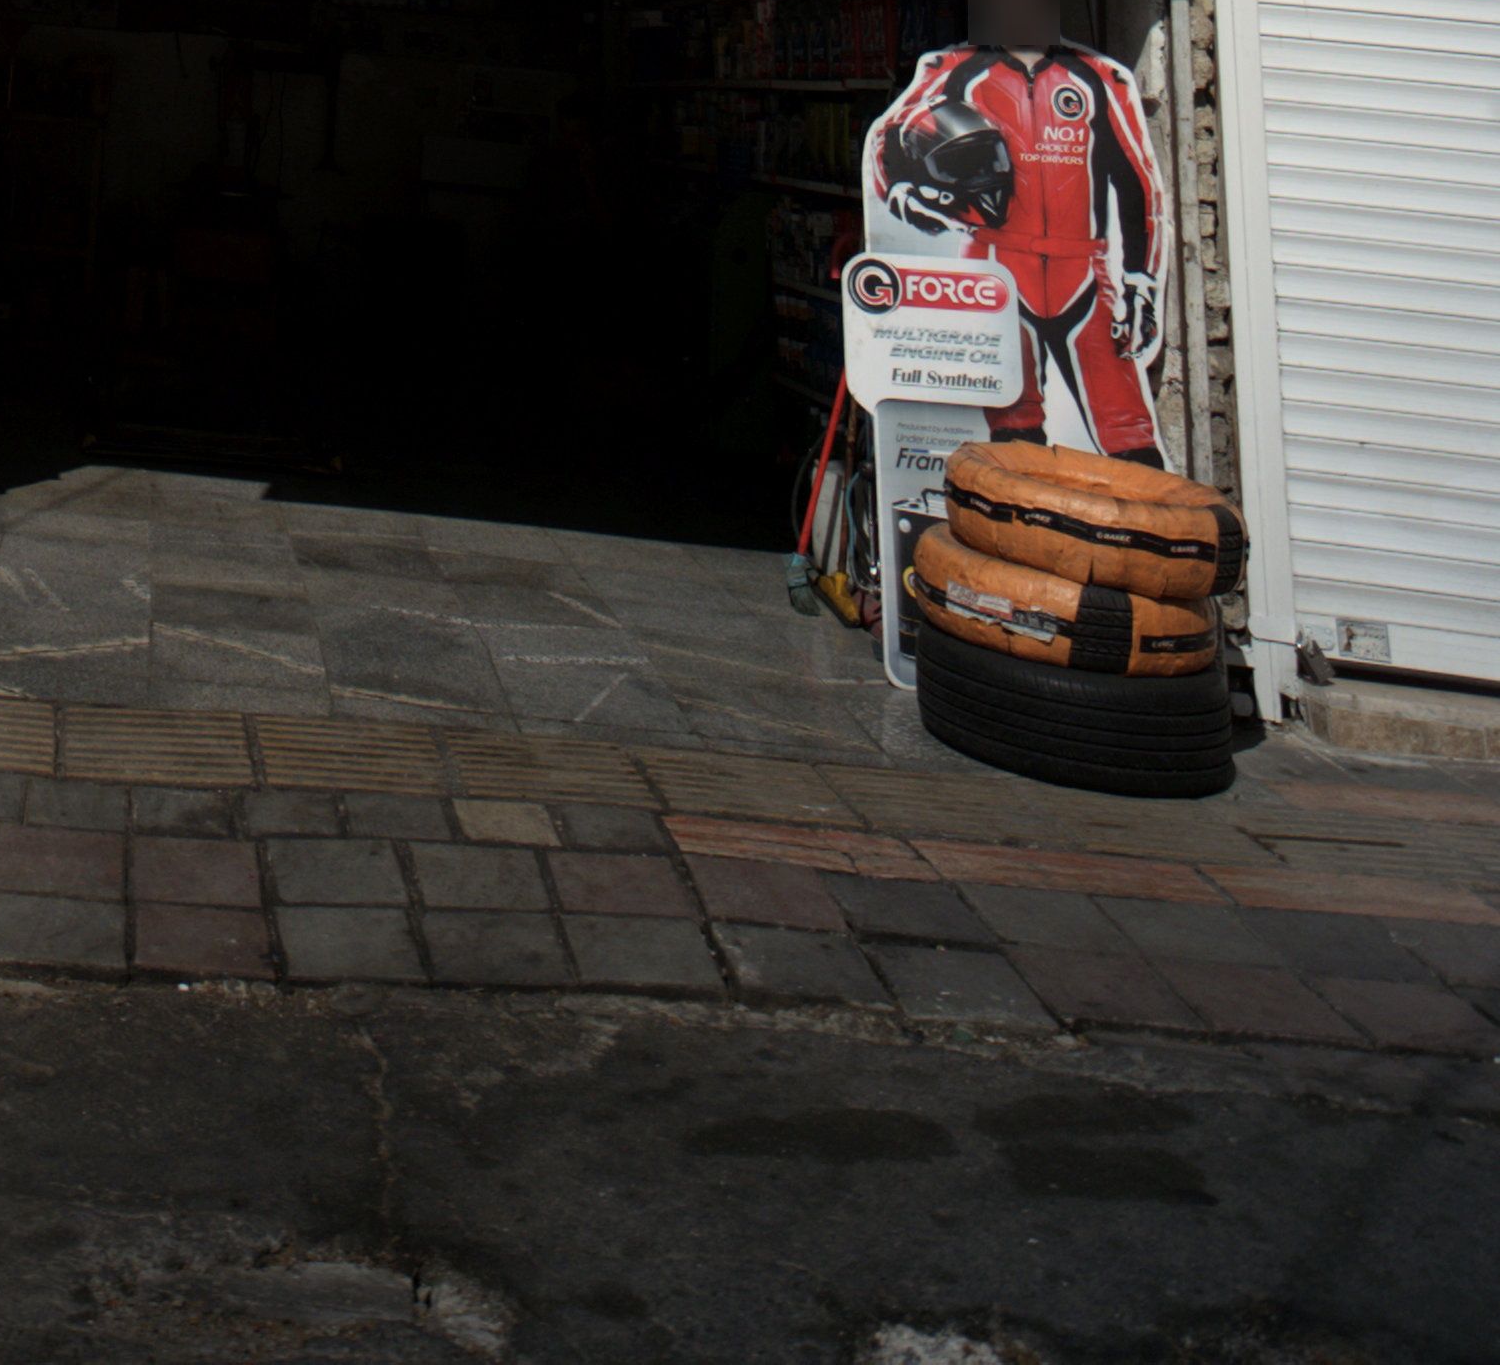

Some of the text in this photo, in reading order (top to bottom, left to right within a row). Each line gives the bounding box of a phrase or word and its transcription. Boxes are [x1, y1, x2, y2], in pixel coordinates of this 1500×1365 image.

[1035, 142, 1086, 154] CHOICE OF
[1020, 153, 1084, 166] TOP DRIVERS
[905, 275, 996, 306] FORCE
[873, 327, 1002, 347] MULTIGRADE
[890, 344, 1002, 365] ENGINE OIL
[892, 367, 1003, 391] Full Synthetic
[896, 434, 925, 444] Under
